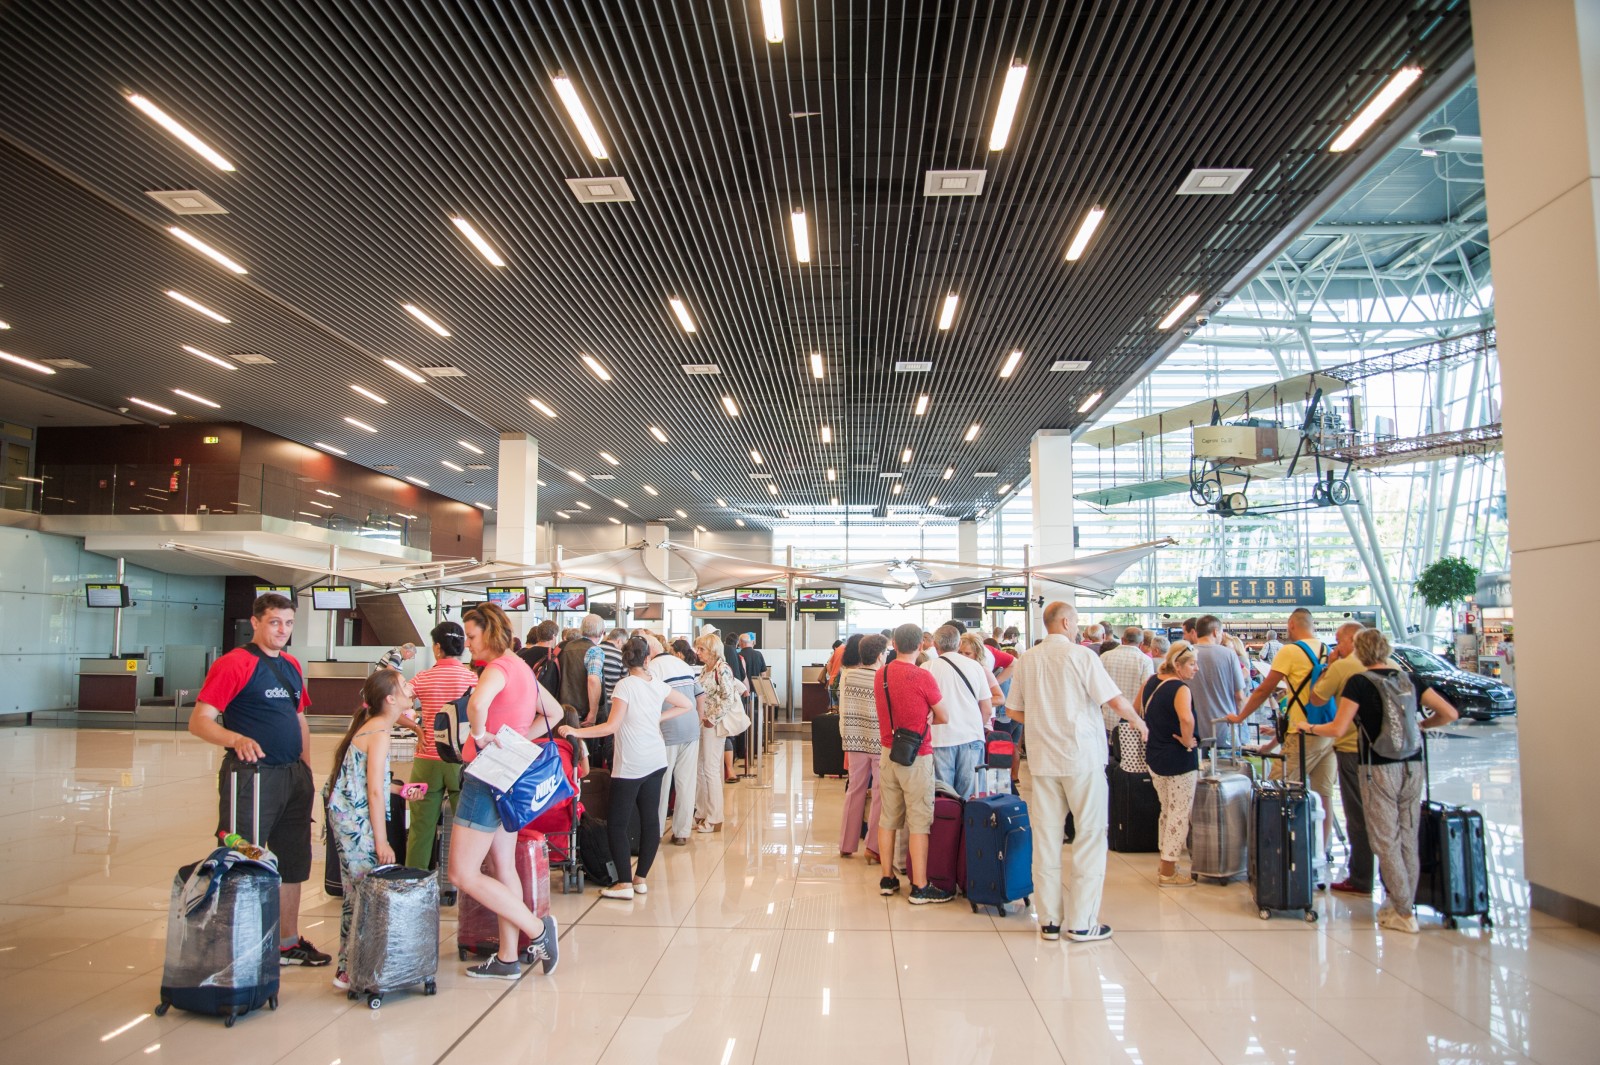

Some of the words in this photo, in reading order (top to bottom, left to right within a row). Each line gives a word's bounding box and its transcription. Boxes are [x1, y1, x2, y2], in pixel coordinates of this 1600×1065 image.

[1213, 580, 1311, 596] JETBAR
[264, 687, 292, 699] adida
[535, 774, 557, 801] NIKE
